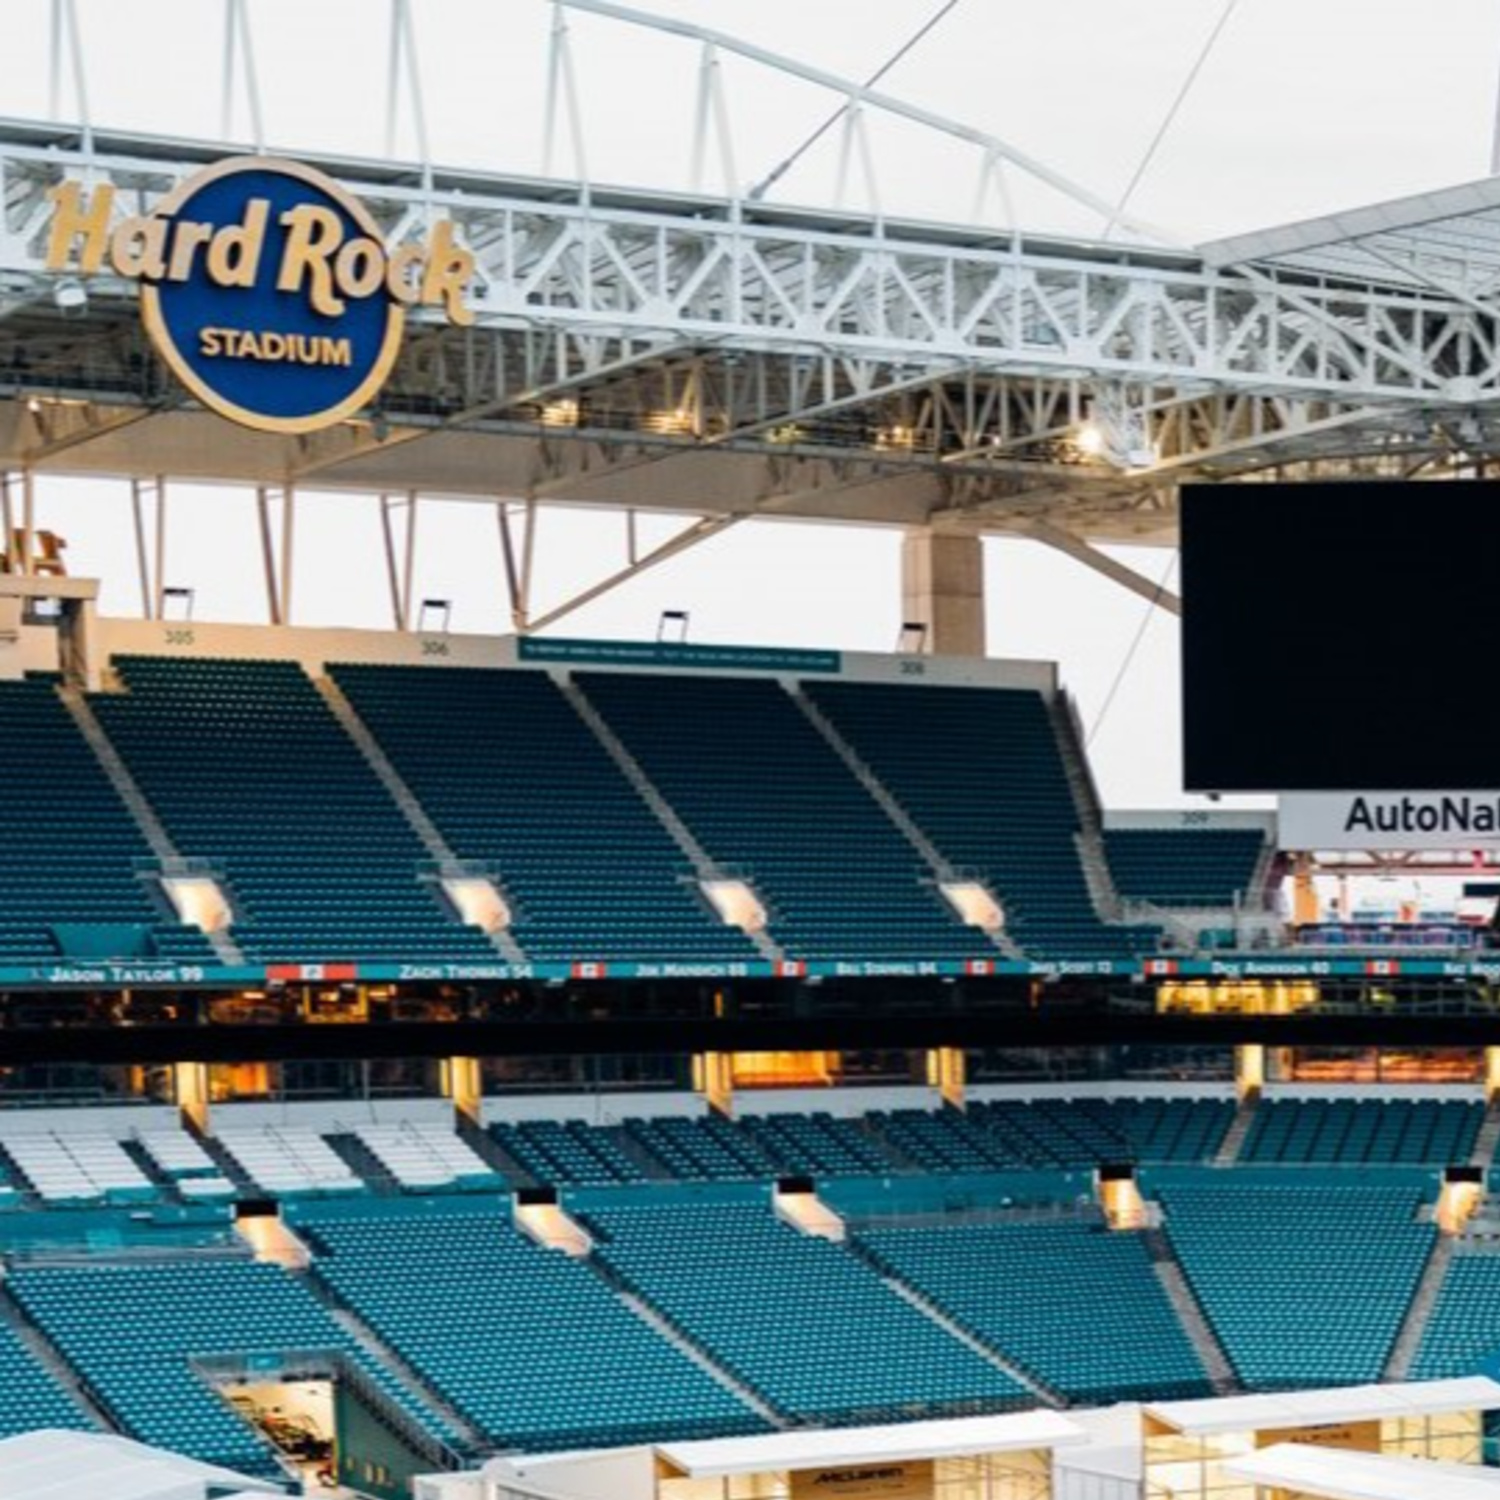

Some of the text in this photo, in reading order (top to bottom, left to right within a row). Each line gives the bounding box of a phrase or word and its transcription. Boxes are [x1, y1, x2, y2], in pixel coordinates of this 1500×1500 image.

[46, 180, 476, 327] Hard Rock
[200, 328, 352, 367] STADIUM
